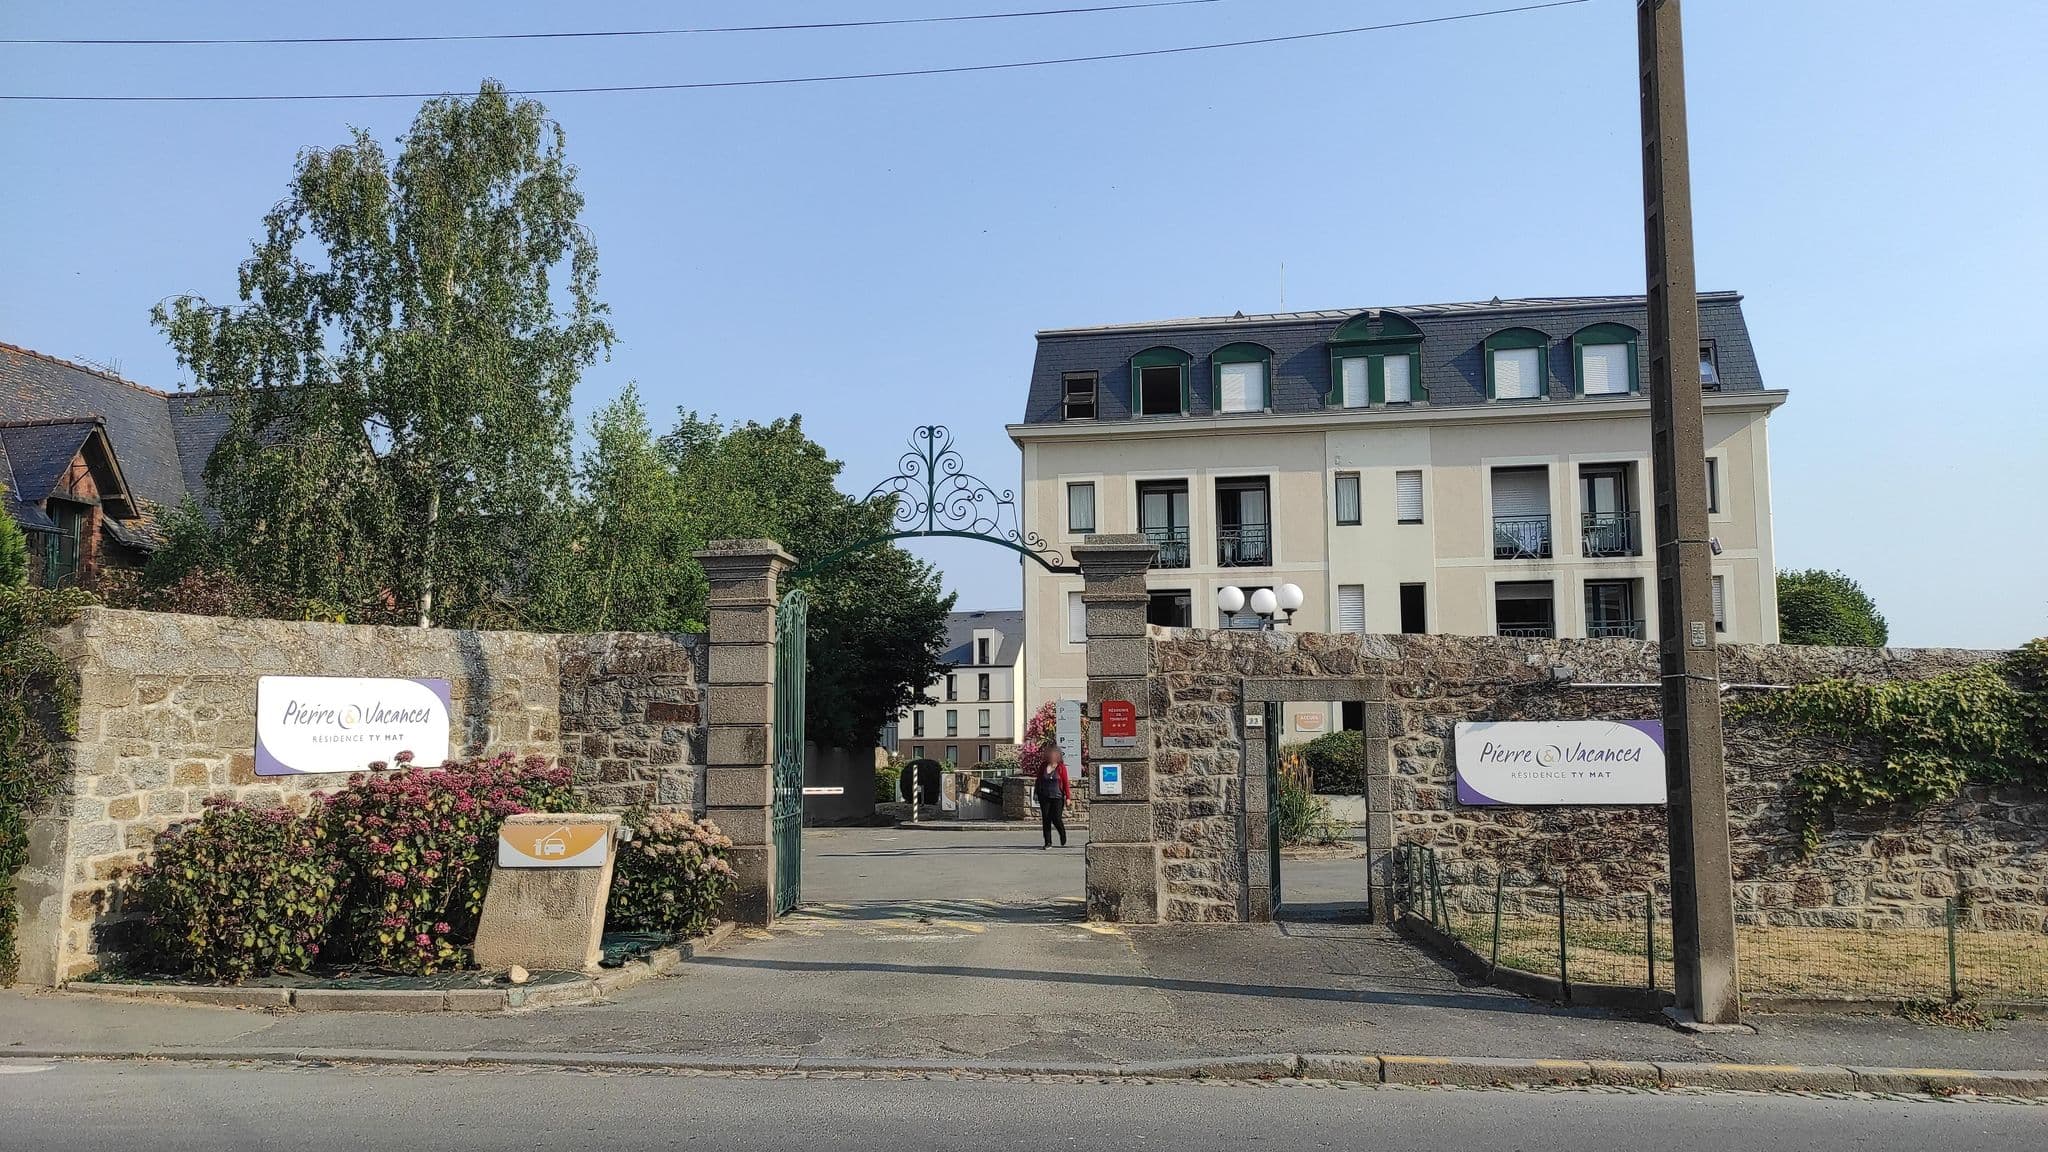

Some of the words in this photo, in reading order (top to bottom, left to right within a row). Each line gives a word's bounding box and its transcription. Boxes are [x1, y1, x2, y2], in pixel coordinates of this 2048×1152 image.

[283, 700, 335, 725] Pierre
[365, 701, 431, 725] Vacances
[368, 734, 381, 742] TY
[1480, 741, 1532, 763] Pierre
[1565, 741, 1642, 763] Vacances
[1511, 770, 1566, 778] RÉSIDENCE
